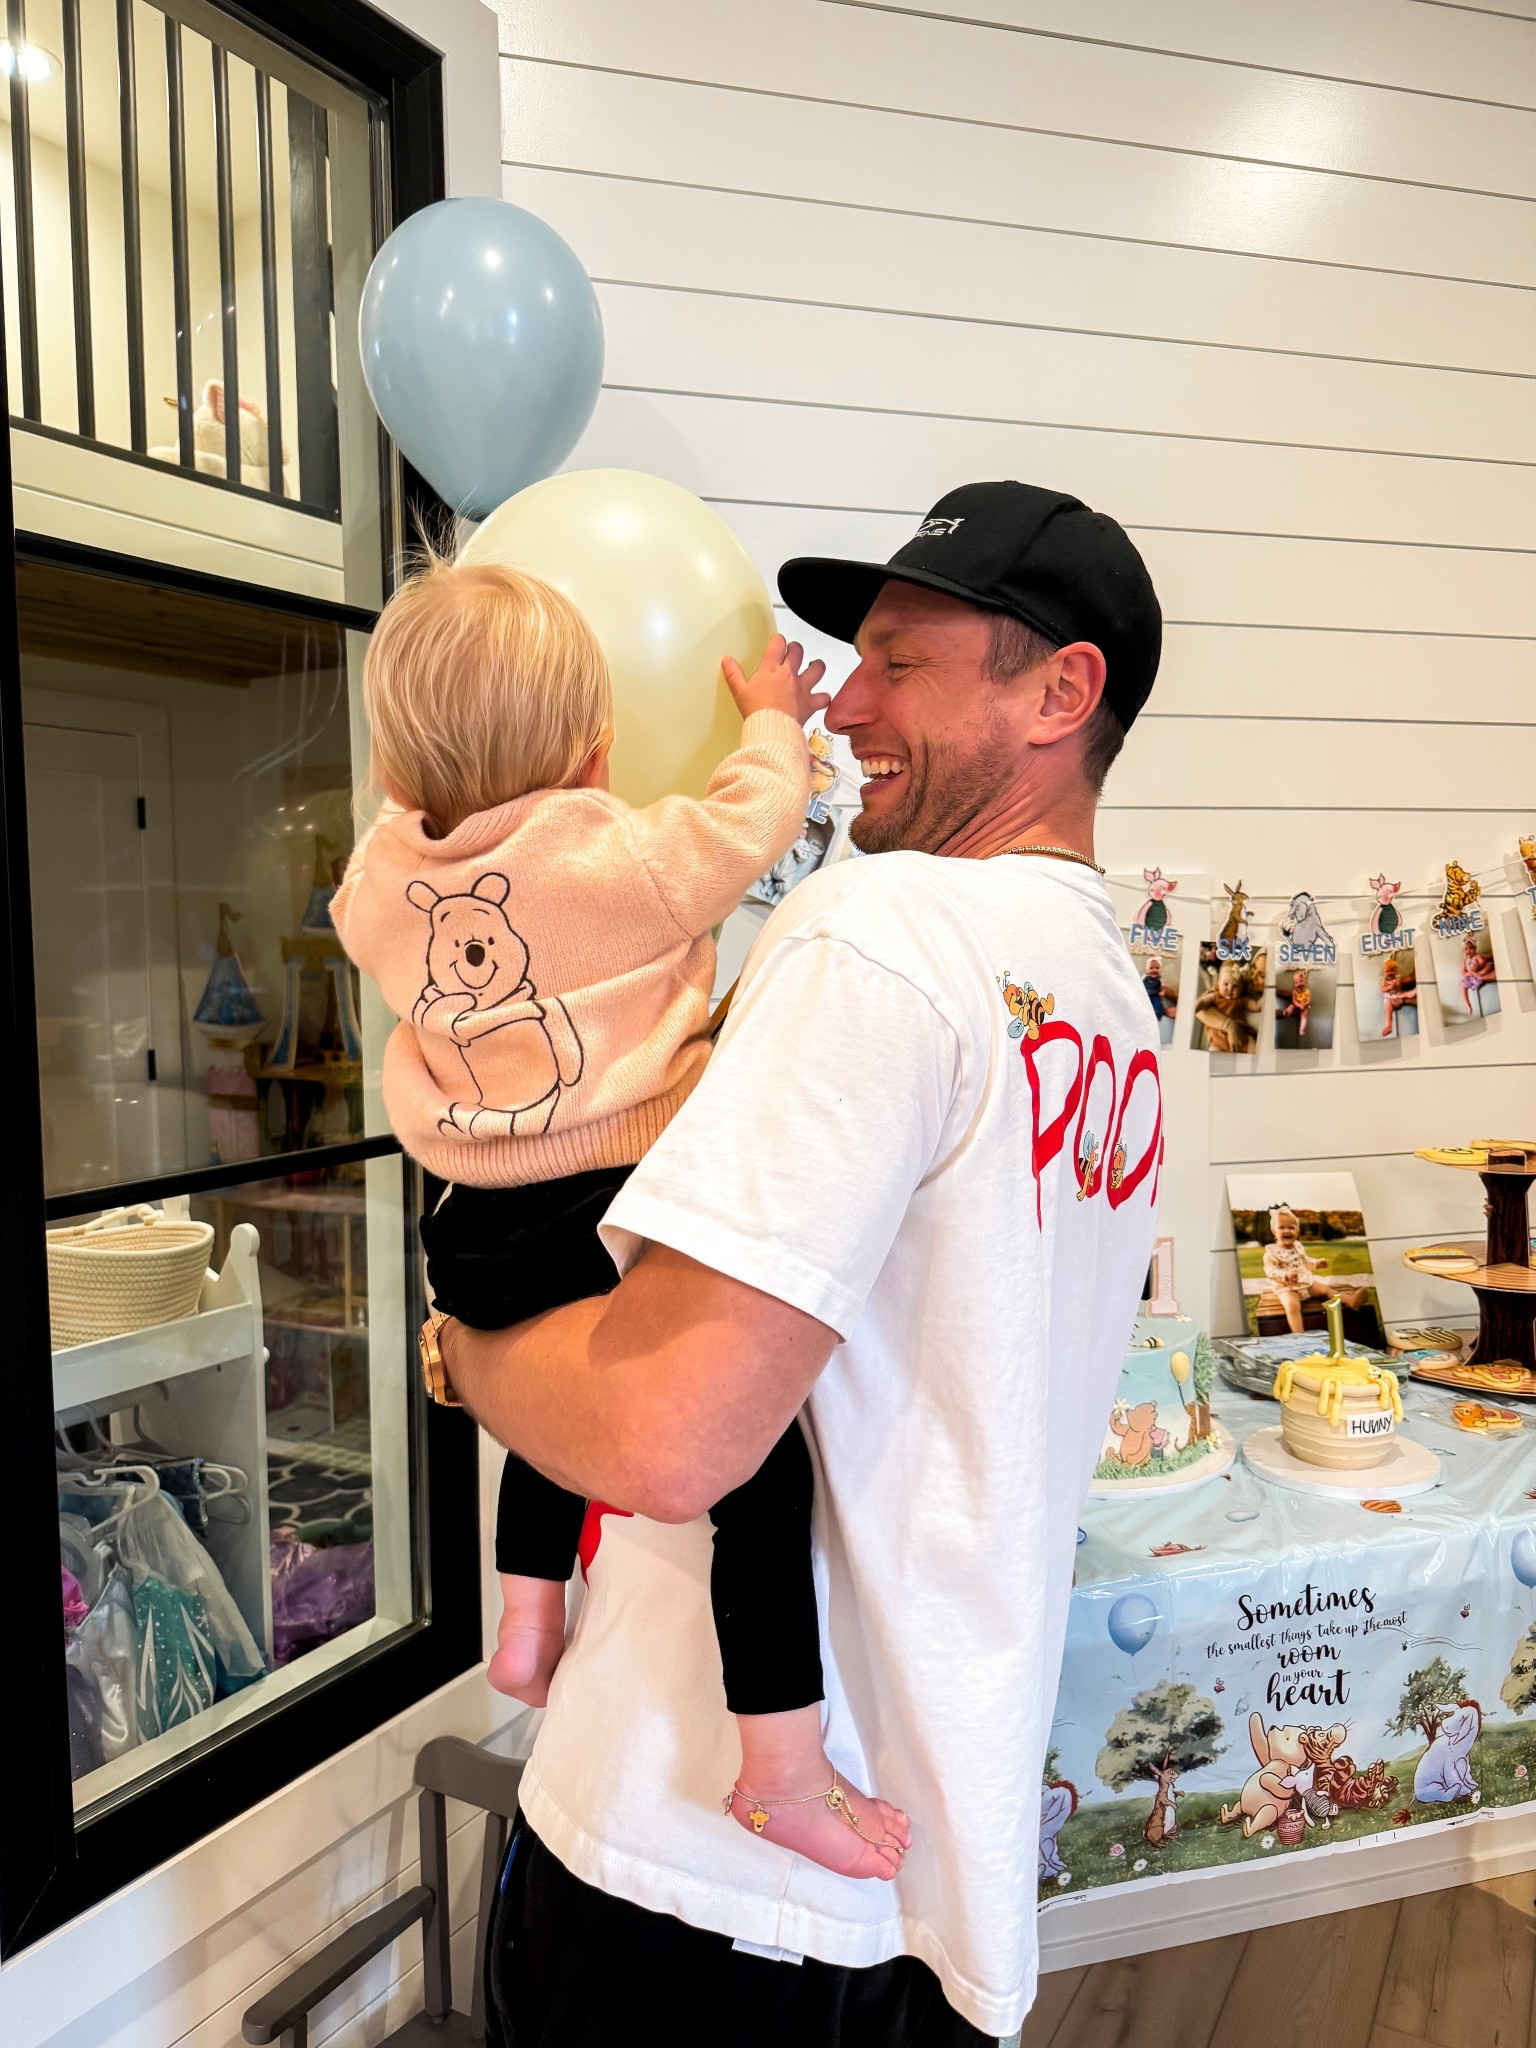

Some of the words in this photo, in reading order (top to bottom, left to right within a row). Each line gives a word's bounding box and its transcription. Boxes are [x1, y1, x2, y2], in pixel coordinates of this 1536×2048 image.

[1129, 923, 1178, 949] FIVE
[1437, 910, 1484, 937] NINE
[1217, 938, 1250, 960] SIX
[1278, 943, 1336, 963] SEVEN
[1360, 927, 1416, 953] EIGHT
[1236, 1583, 1377, 1631] Sometimes
[1204, 1641, 1226, 1659] the
[1228, 1633, 1277, 1655] smallest
[1279, 1627, 1313, 1645] things
[1315, 1619, 1344, 1637] take
[1344, 1623, 1359, 1638] up
[1362, 1616, 1383, 1635] the
[1382, 1610, 1408, 1627] most
[1276, 1644, 1342, 1669] room
[1266, 1668, 1351, 1712] heart
[1282, 1671, 1293, 1683] in
[1292, 1668, 1324, 1686] your
